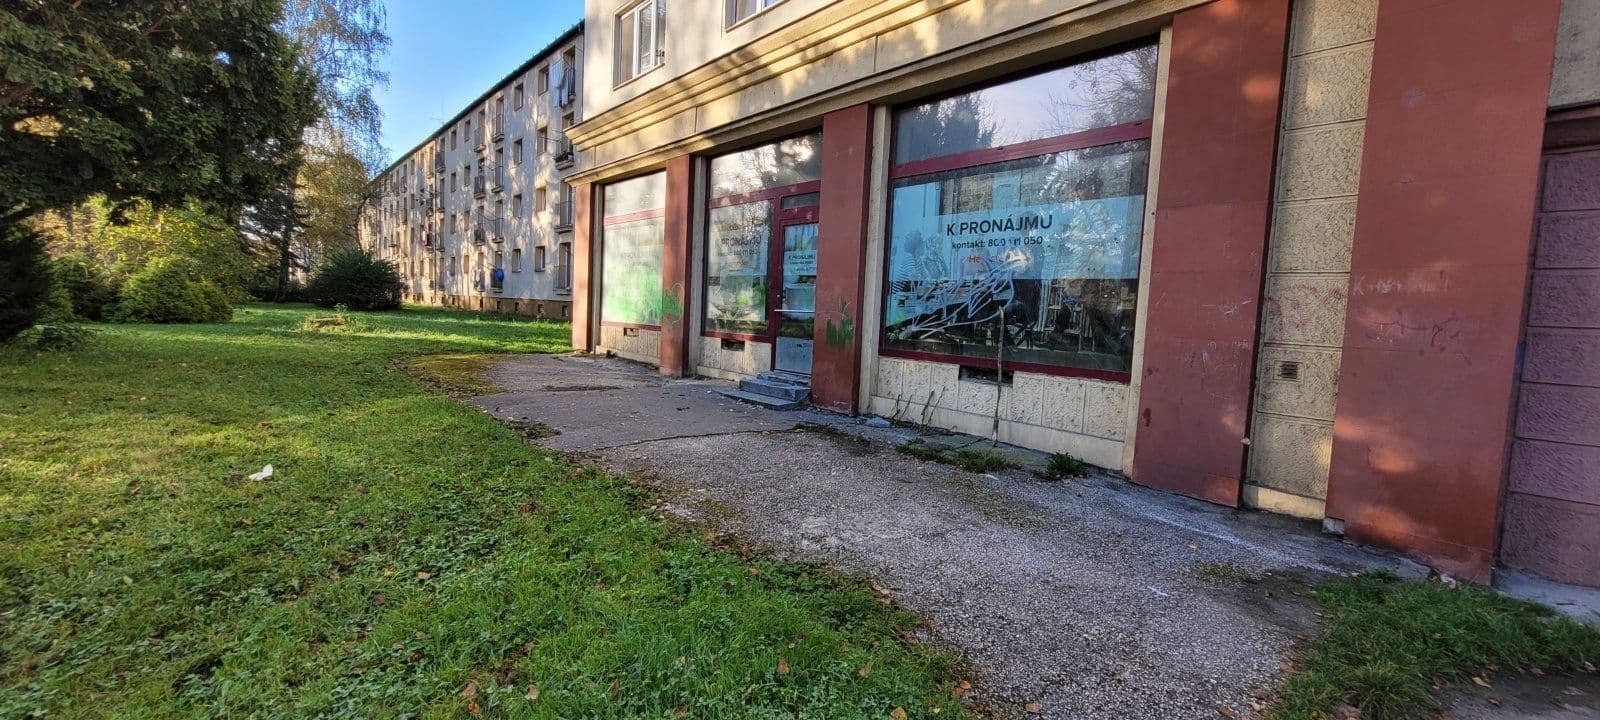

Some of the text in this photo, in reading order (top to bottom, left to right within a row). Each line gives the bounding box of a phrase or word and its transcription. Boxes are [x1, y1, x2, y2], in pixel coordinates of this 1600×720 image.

[946, 214, 1053, 236] K PRONÁJMU
[952, 240, 986, 249] kontakt:
[988, 238, 1006, 247] 800
[1023, 236, 1043, 245] 050
